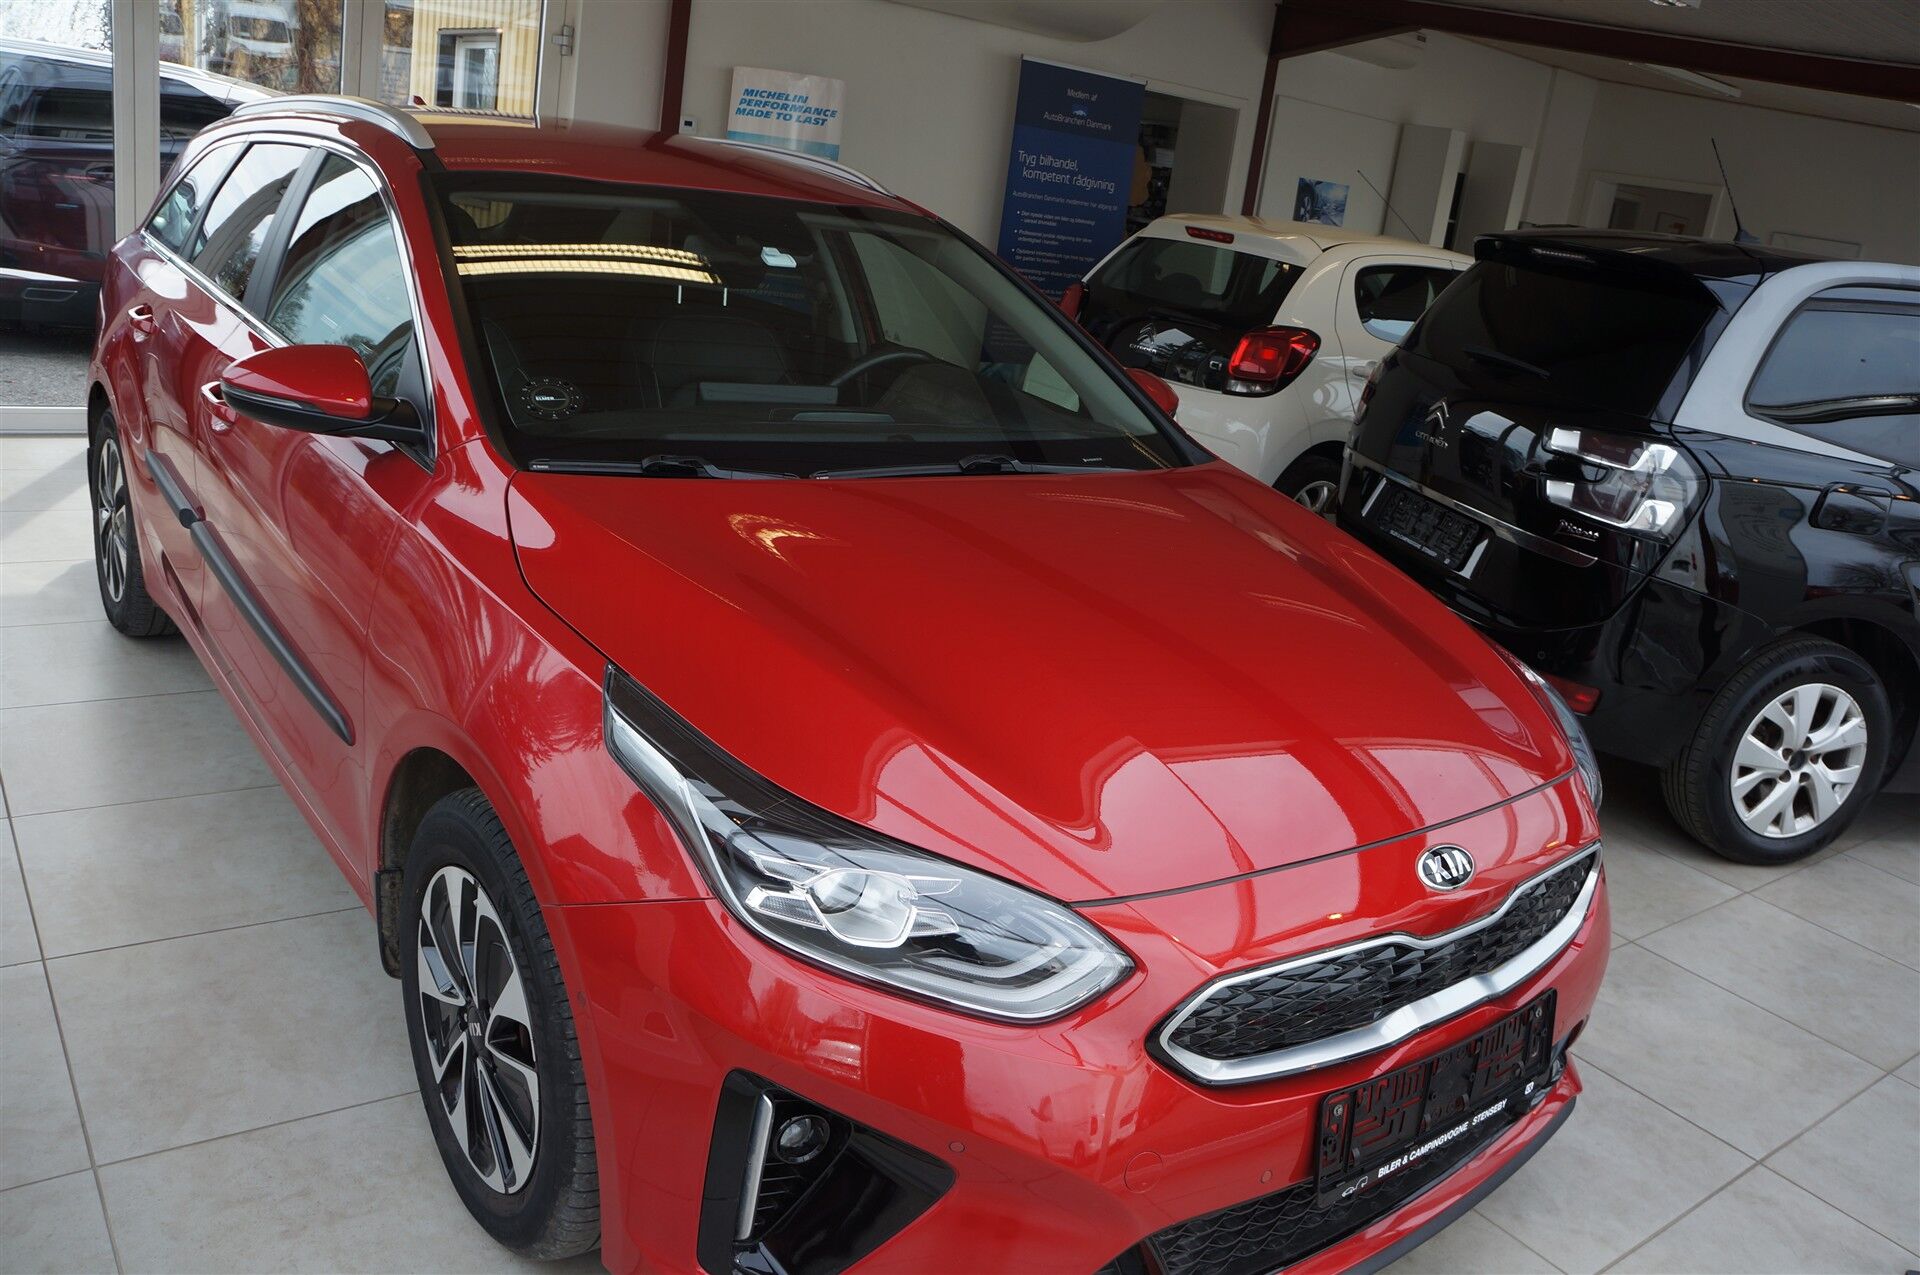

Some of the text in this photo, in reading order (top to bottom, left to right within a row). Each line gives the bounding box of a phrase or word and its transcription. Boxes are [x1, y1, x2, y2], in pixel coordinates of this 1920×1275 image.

[743, 88, 808, 104] MICHELIN
[1067, 88, 1098, 102] Medlem af
[735, 107, 828, 126] MADE TO LAST
[739, 98, 838, 118] PERFORMANCE
[1043, 111, 1112, 131] AutoBranchen Danmark
[1018, 150, 1079, 171] Tryg bilhandel,
[1022, 166, 1115, 194] kompetent rådgivning
[1425, 850, 1472, 883] KIA
[1377, 1098, 1508, 1178] BILER & CAMPINGVOGNE STENSEBY
